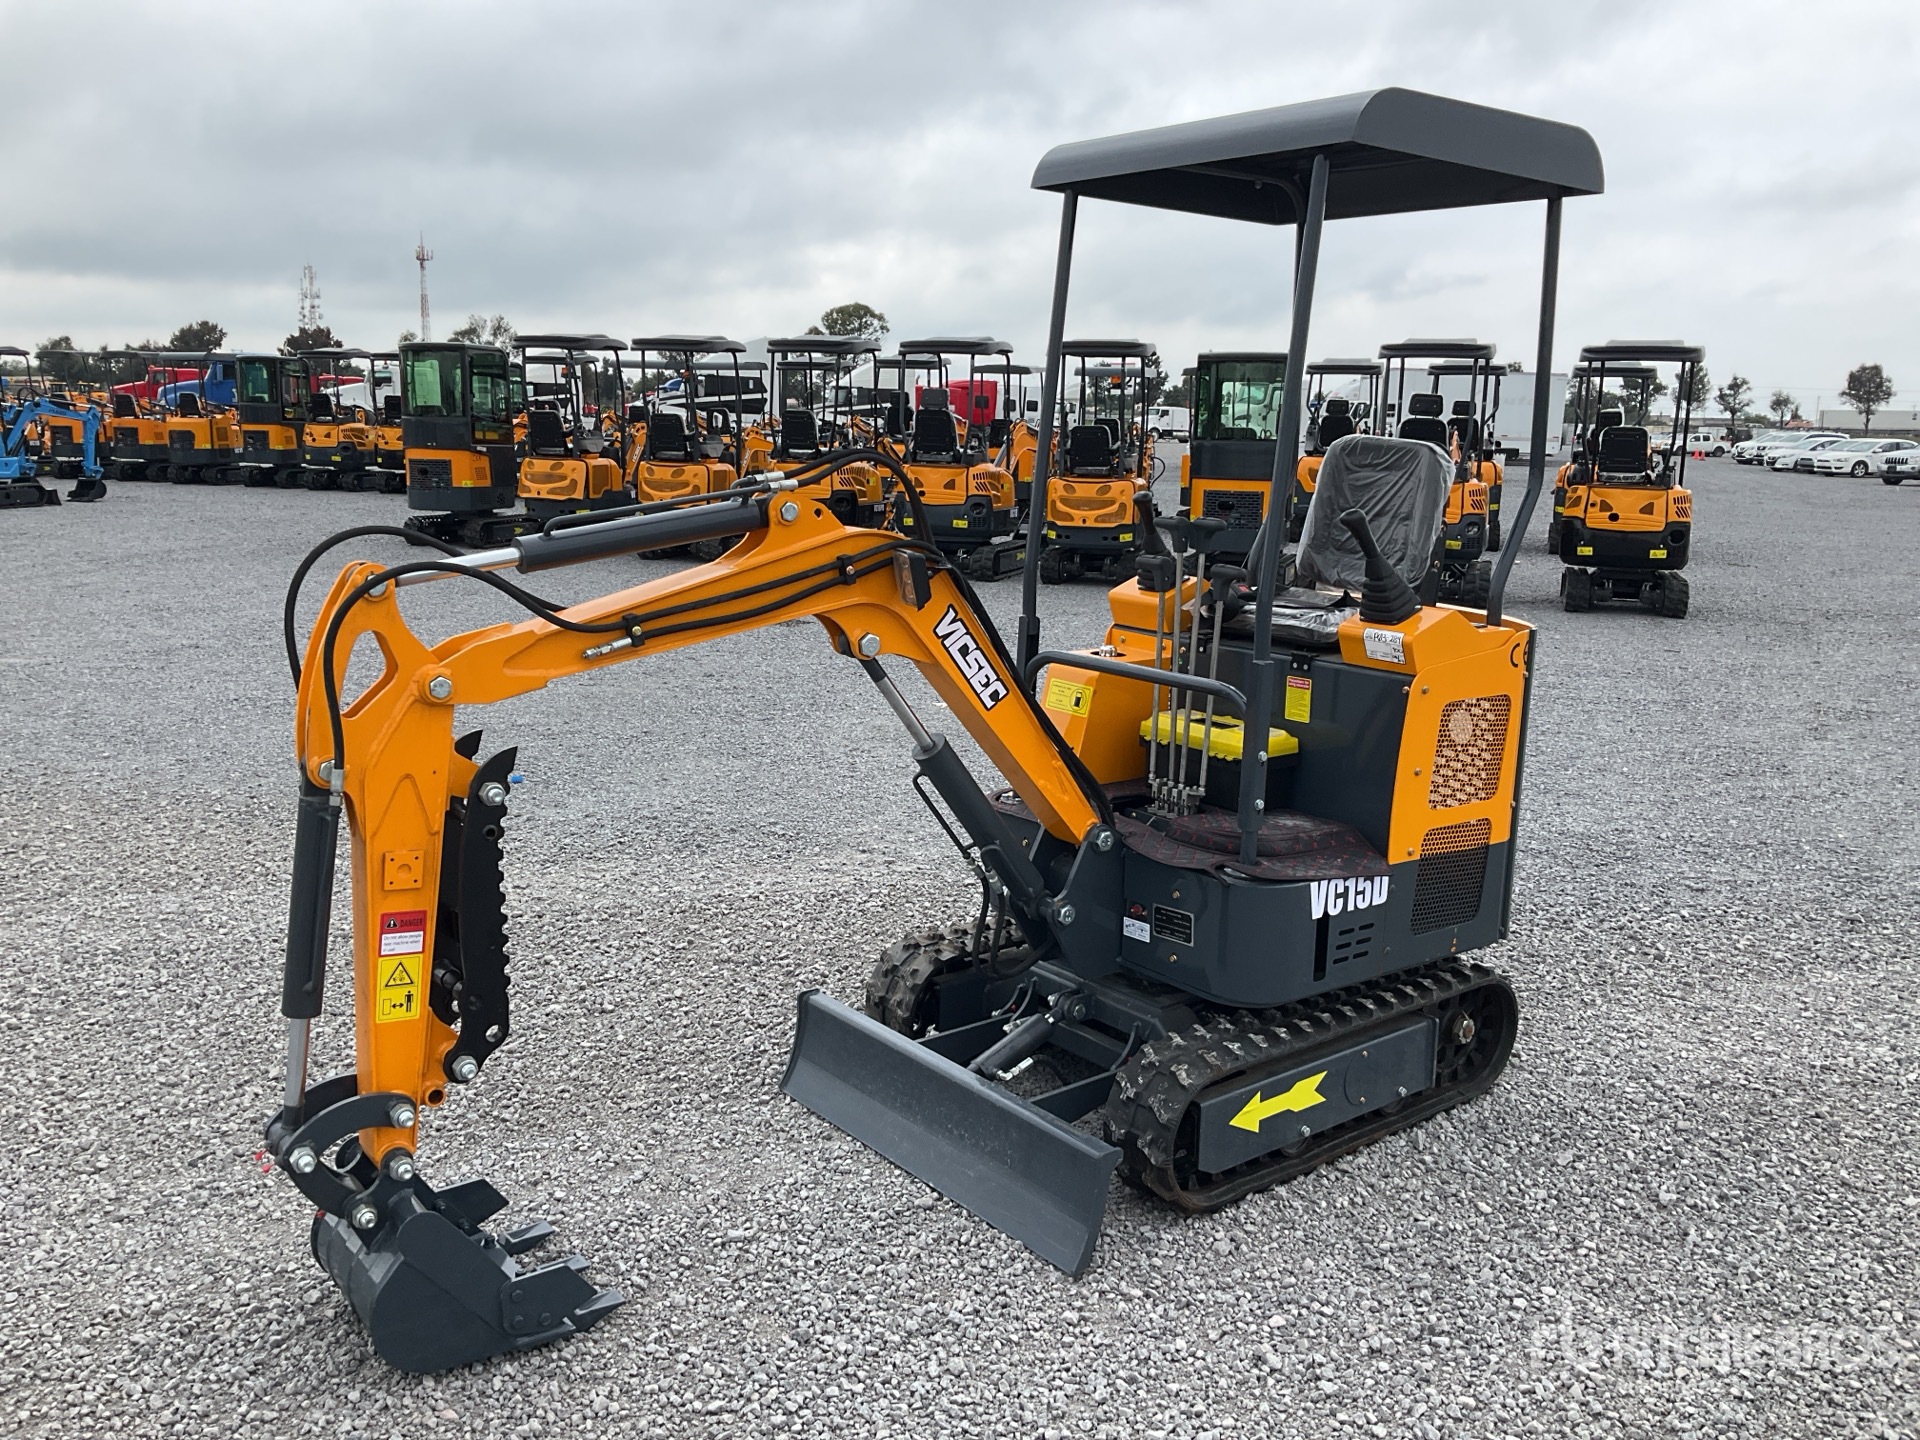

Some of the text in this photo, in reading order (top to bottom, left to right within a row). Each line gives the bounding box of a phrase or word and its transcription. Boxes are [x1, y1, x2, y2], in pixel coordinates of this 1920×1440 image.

[934, 605, 1009, 710] VICSEC
[1310, 876, 1390, 920] VC15D
[400, 918, 423, 927] DANGER
